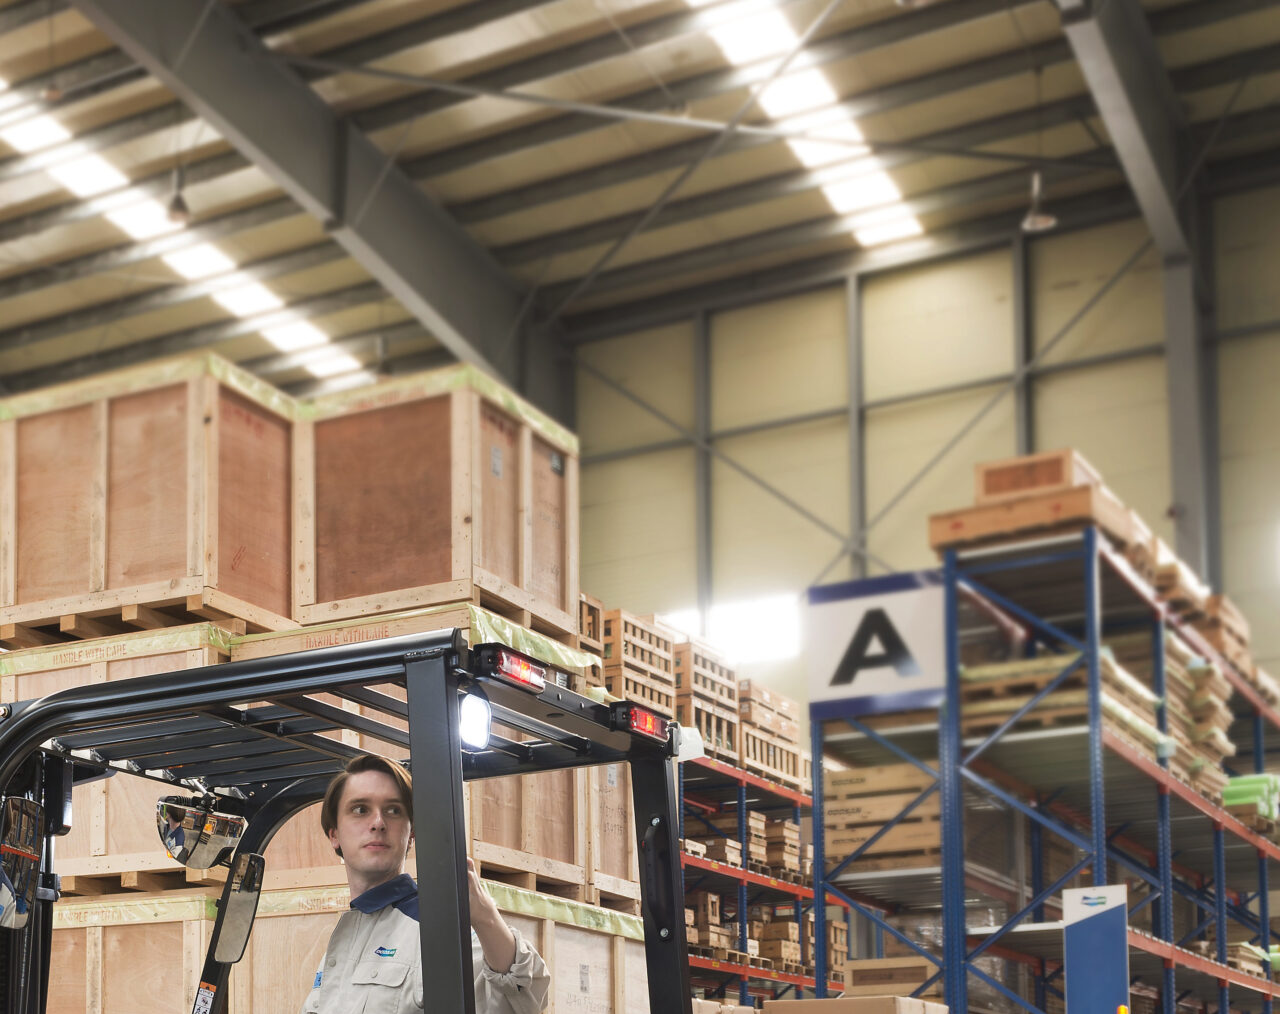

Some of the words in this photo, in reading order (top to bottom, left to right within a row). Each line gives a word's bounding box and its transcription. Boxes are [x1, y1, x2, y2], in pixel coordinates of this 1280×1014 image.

[343, 628, 364, 642] WITH
[365, 625, 390, 639] CARE
[85, 647, 104, 659] WITH
[106, 644, 127, 657] CARE
[828, 607, 923, 687] A
